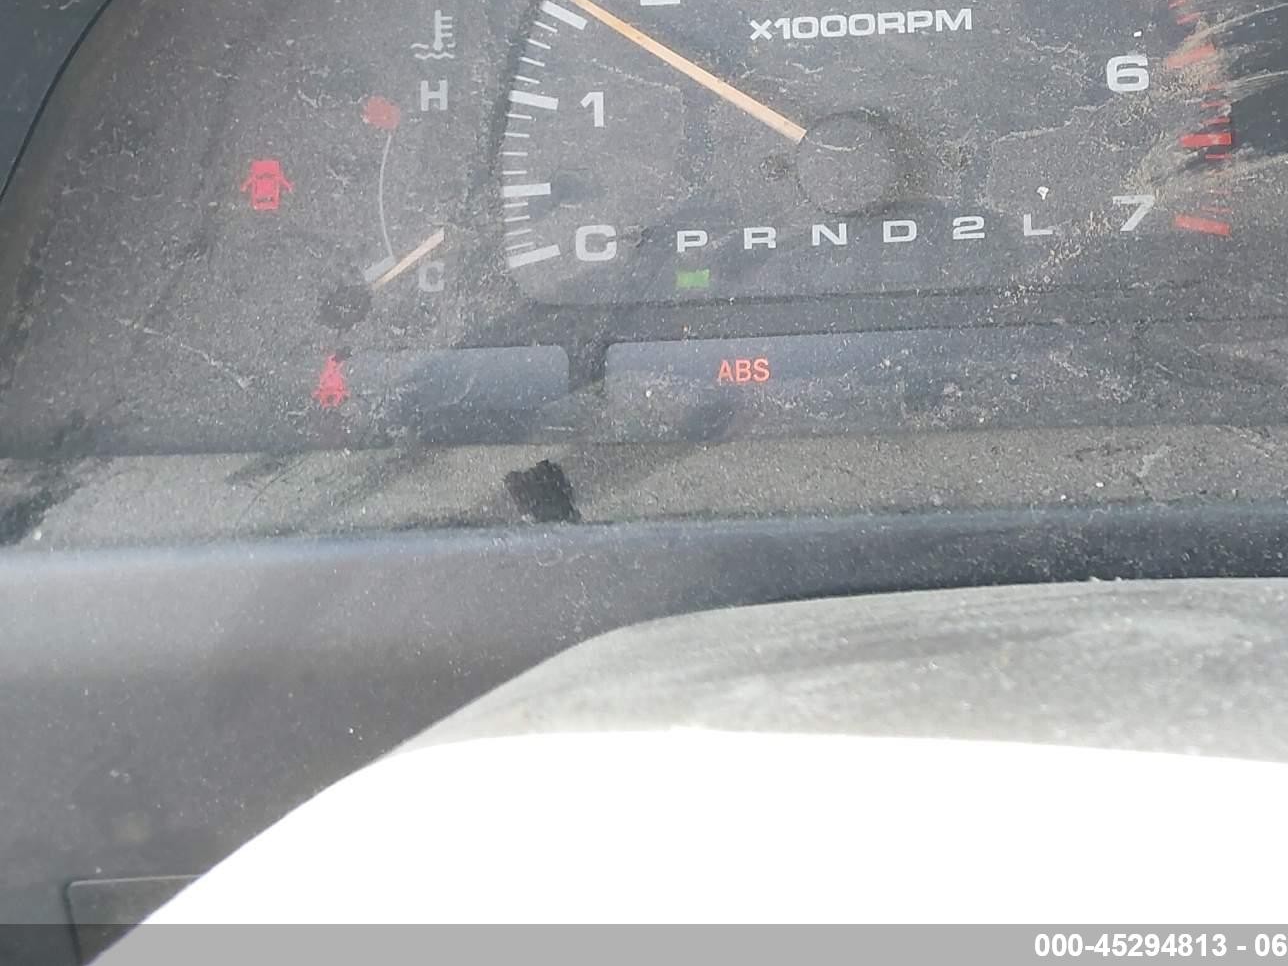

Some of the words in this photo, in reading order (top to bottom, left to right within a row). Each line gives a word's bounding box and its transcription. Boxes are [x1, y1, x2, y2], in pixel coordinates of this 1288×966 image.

[1106, 54, 1149, 92] 6
[420, 80, 448, 111] H
[580, 91, 605, 127] 1
[1112, 195, 1153, 232] 7
[677, 229, 708, 253] P
[743, 226, 777, 250] R
[811, 223, 848, 246] N
[883, 219, 917, 243] D
[952, 216, 985, 240] 2
[1023, 213, 1053, 236] L
[418, 261, 446, 292] C
[718, 358, 770, 383] ABS
